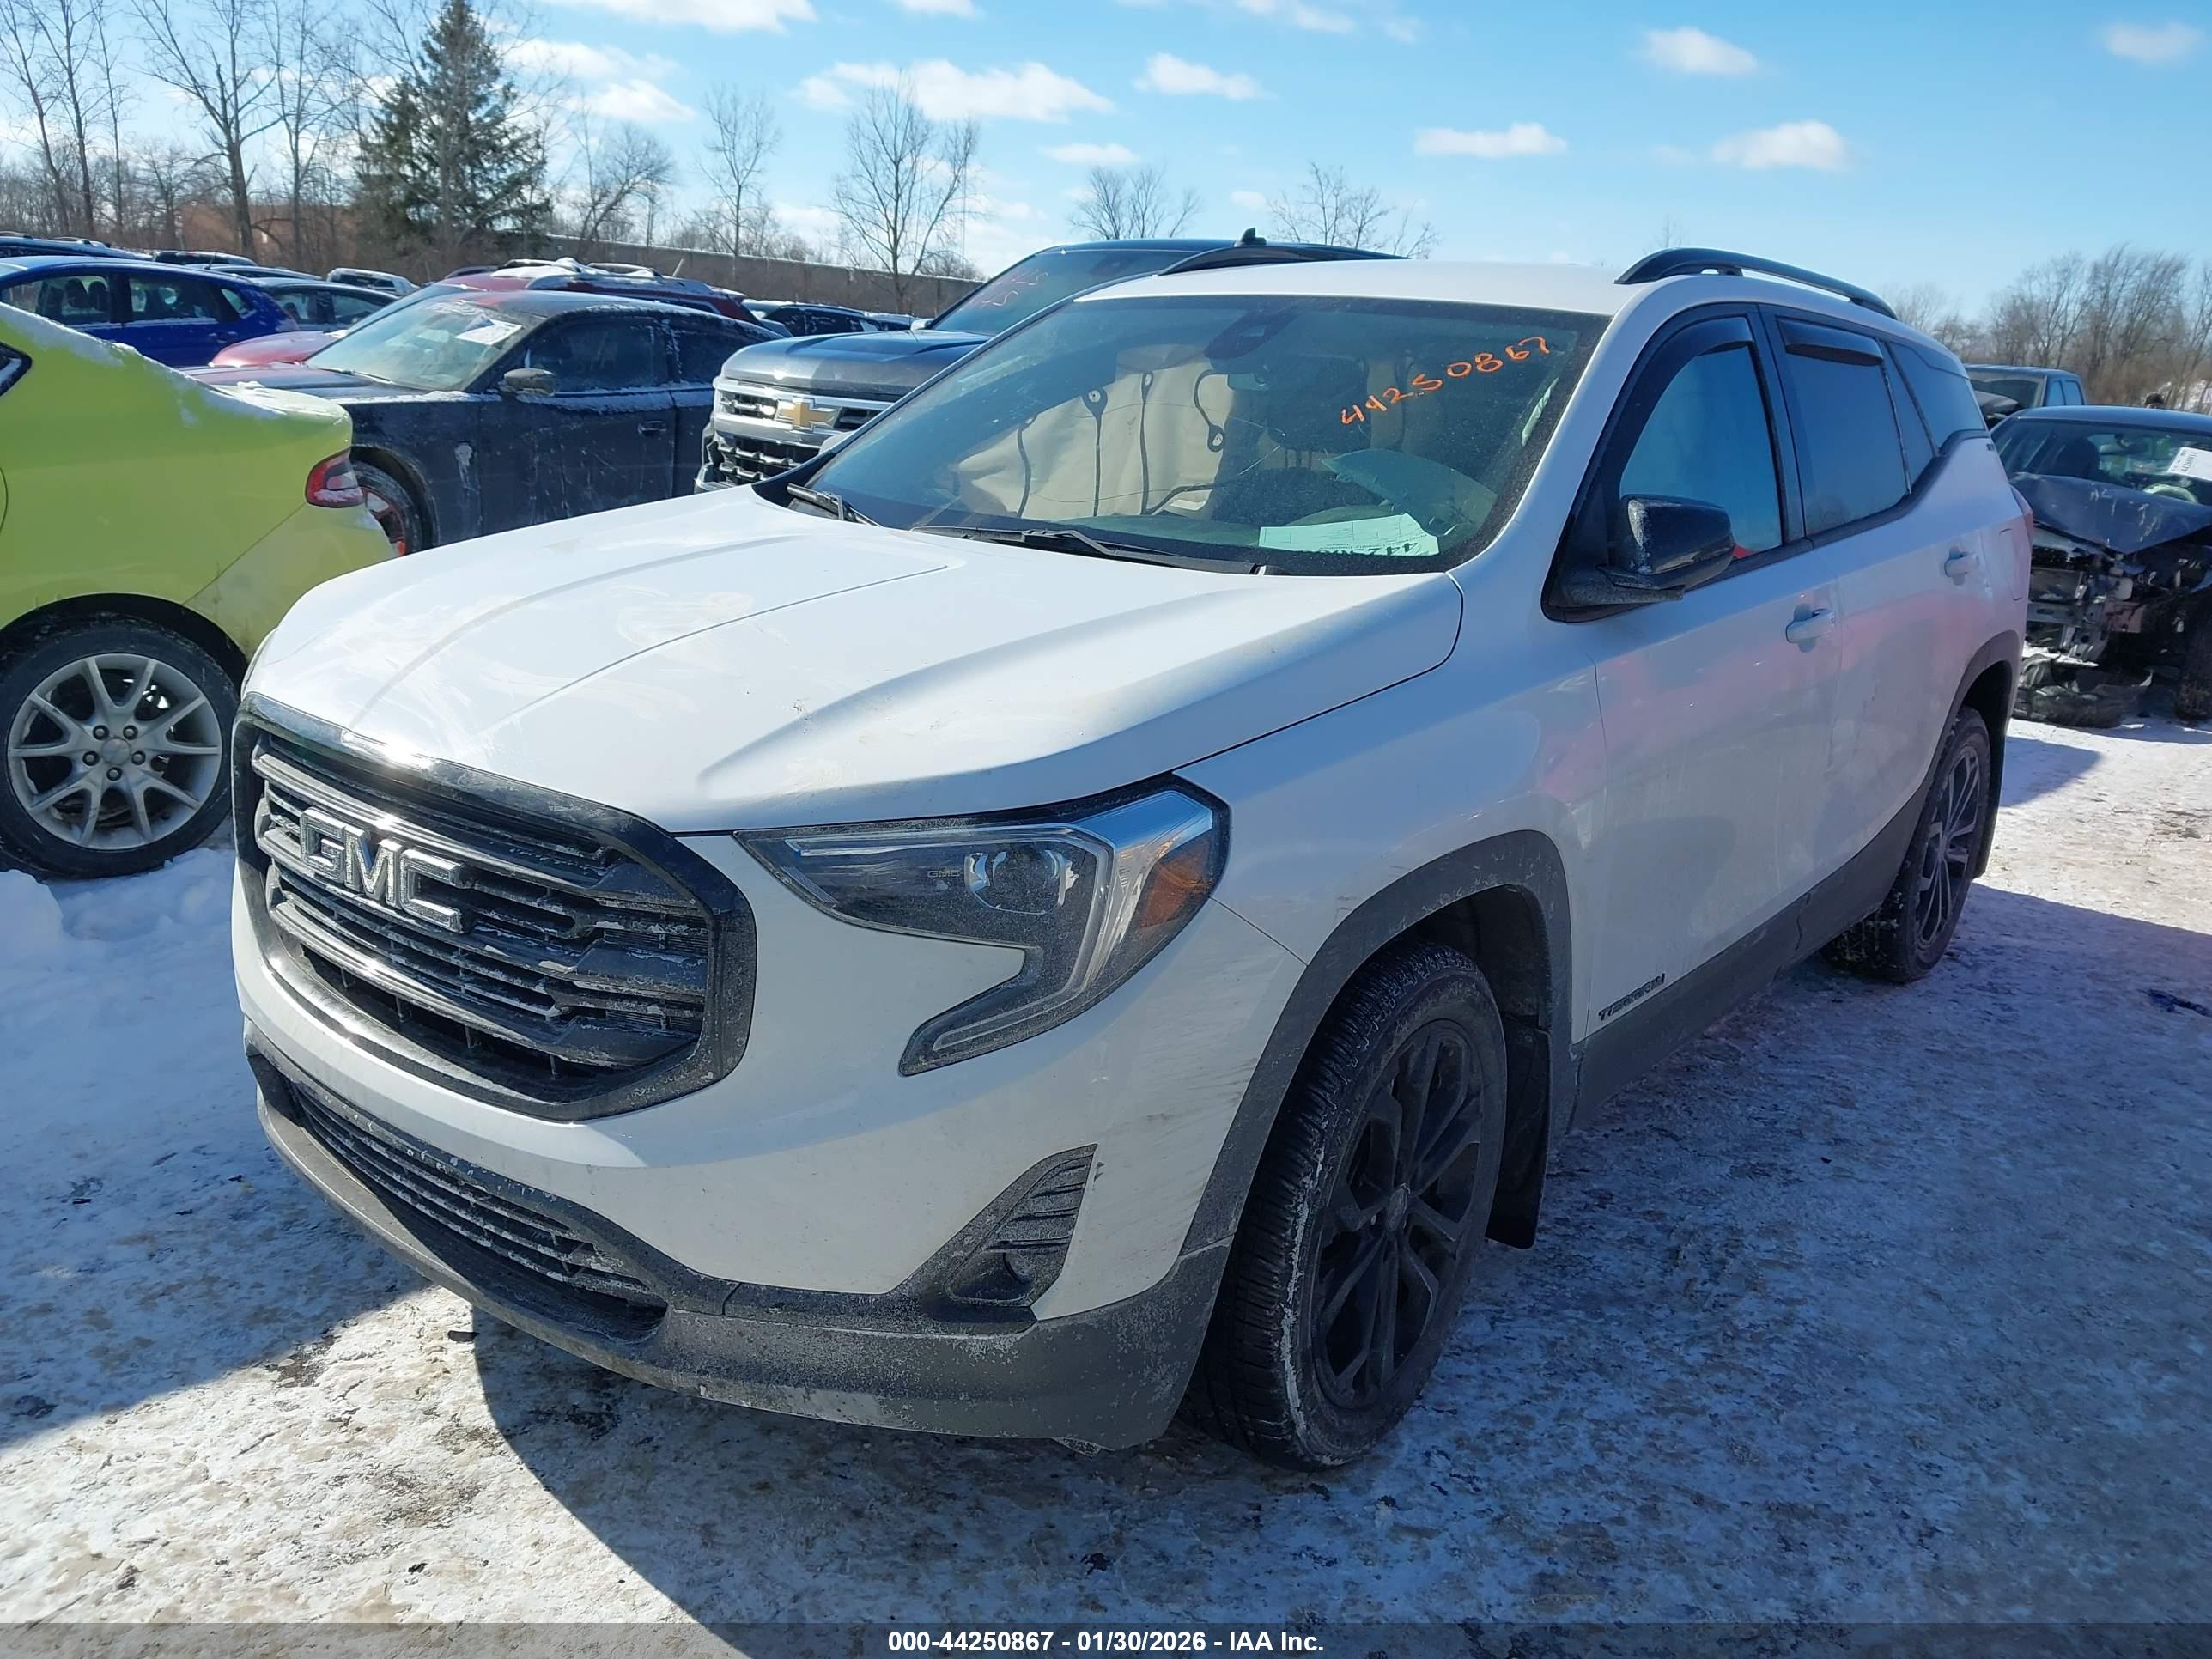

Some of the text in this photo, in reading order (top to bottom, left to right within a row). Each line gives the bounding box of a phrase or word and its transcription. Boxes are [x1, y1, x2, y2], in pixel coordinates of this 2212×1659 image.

[1340, 335, 1551, 424] 44250867
[299, 805, 465, 934] GMC
[1597, 972, 1667, 1022] TERRAIN
